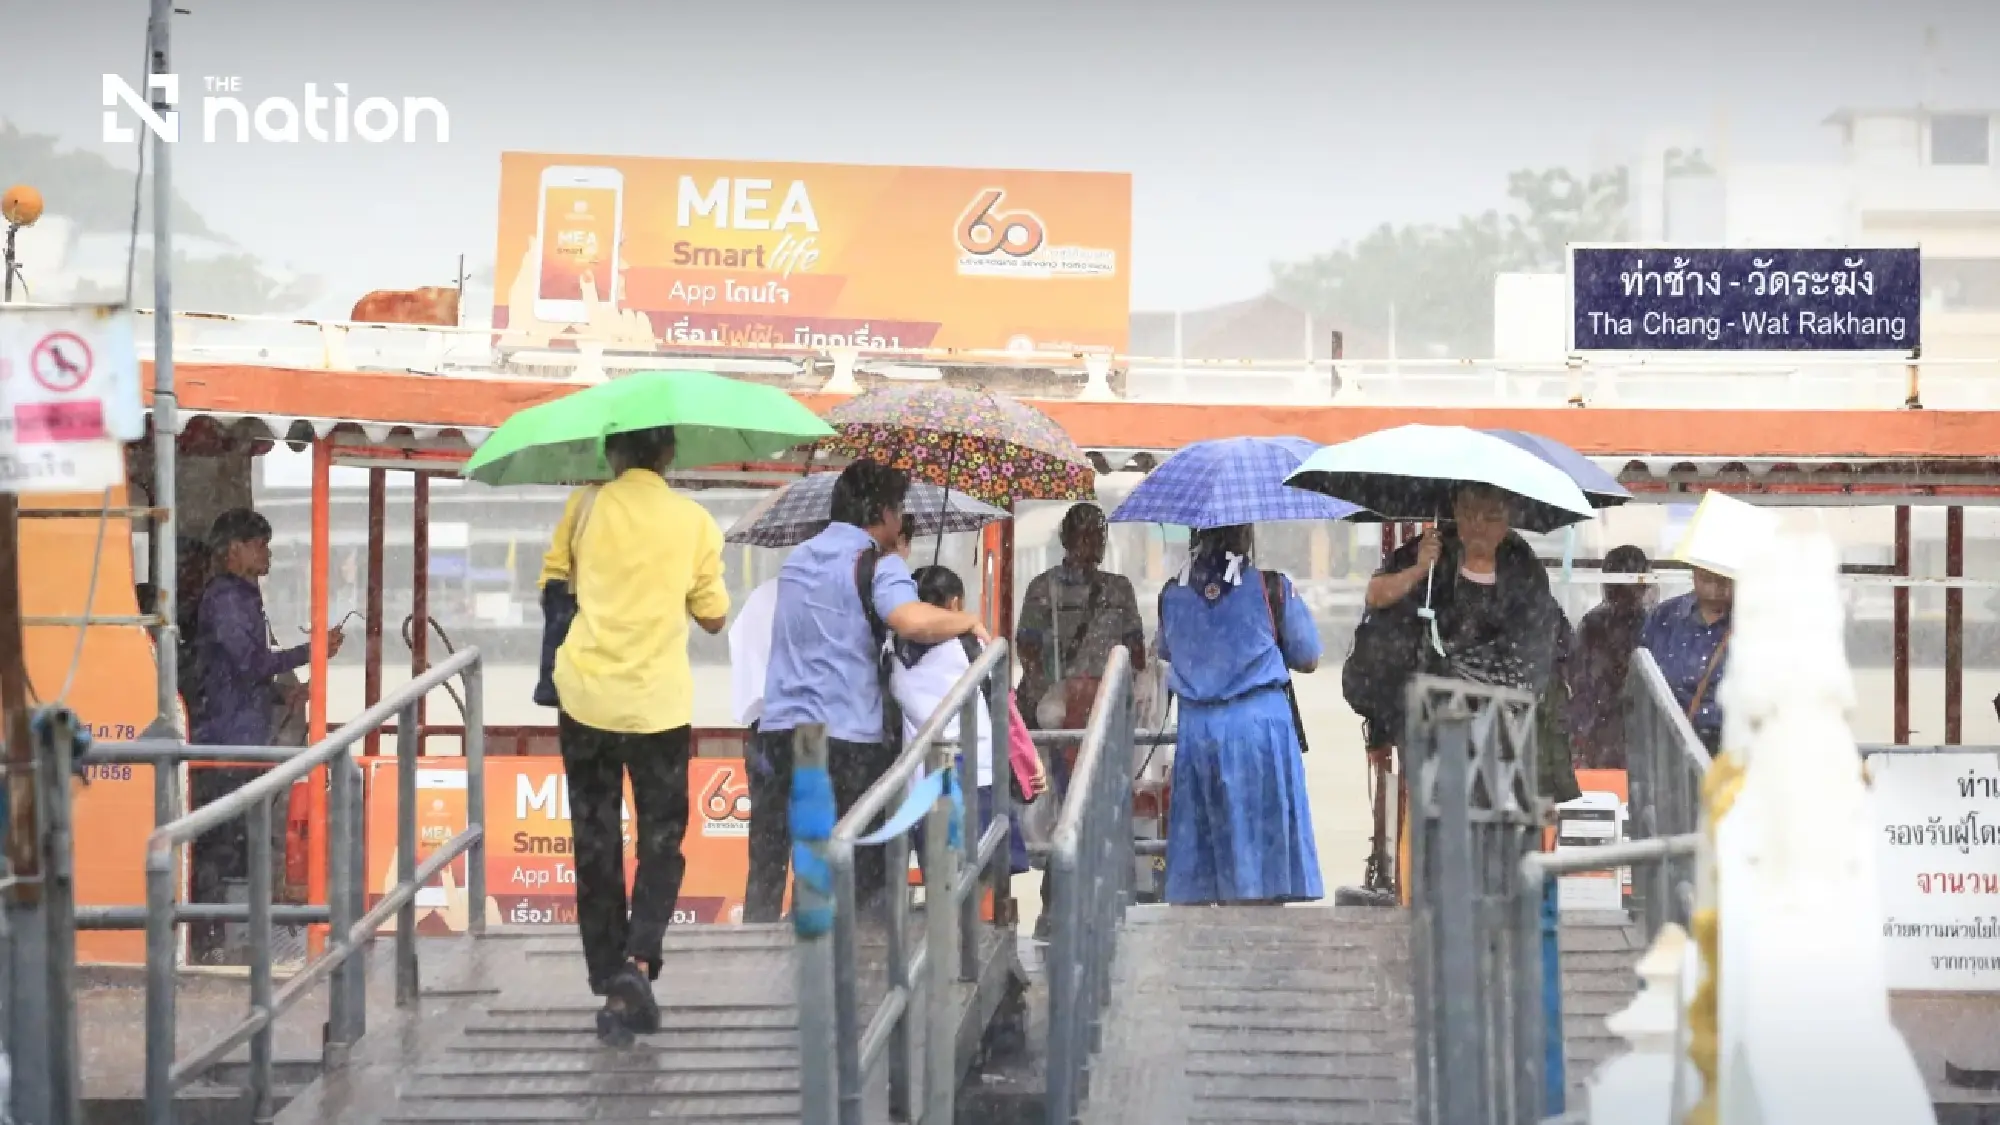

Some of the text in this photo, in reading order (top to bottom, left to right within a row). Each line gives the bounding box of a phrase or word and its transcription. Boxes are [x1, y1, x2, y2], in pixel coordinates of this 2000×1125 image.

[677, 175, 820, 232] MEA
[957, 190, 1044, 257] 60
[673, 232, 821, 280] Smart life
[1620, 256, 1722, 296] ท่าช้าง
[1748, 256, 1874, 296] วัดระฆัง
[668, 278, 791, 307] App โดนใจ
[1587, 311, 1633, 335] Tha
[1643, 311, 1721, 340] Chang
[1741, 311, 1789, 335] Wat
[1799, 311, 1906, 340] Rakhang
[514, 831, 574, 854] Smar
[1884, 810, 2000, 855] รองรับผู้โด
[511, 865, 549, 888] App
